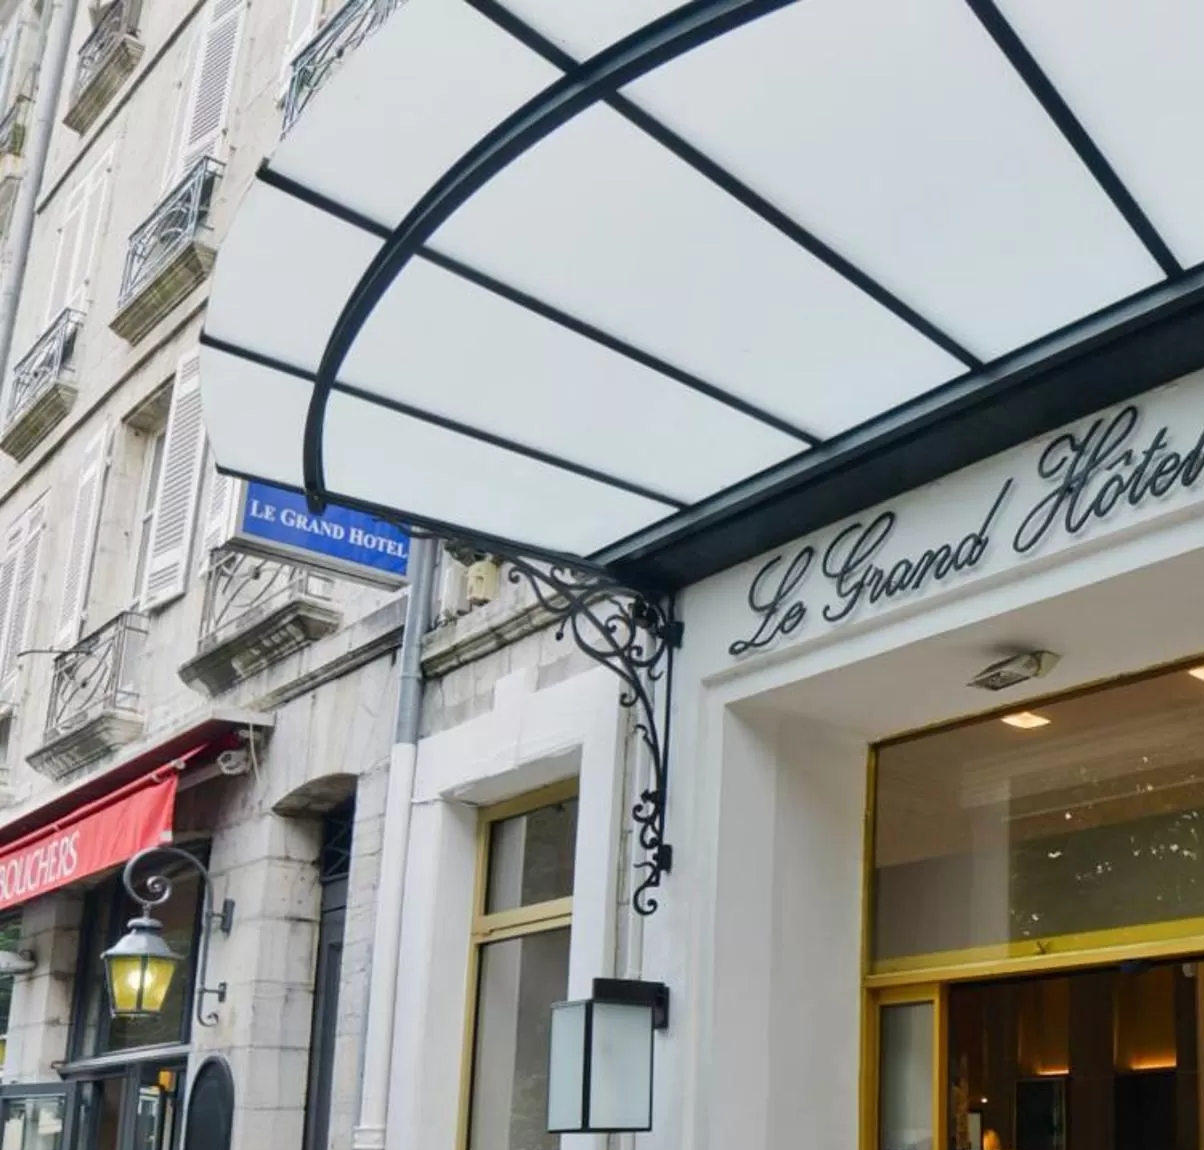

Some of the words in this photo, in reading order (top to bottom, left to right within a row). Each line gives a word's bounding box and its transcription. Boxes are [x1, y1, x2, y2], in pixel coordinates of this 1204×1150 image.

[250, 499, 277, 522] LE
[280, 508, 345, 541] GRAND
[349, 526, 409, 560] HOTEL
[728, 545, 816, 656] Le
[822, 477, 1014, 622] Grand
